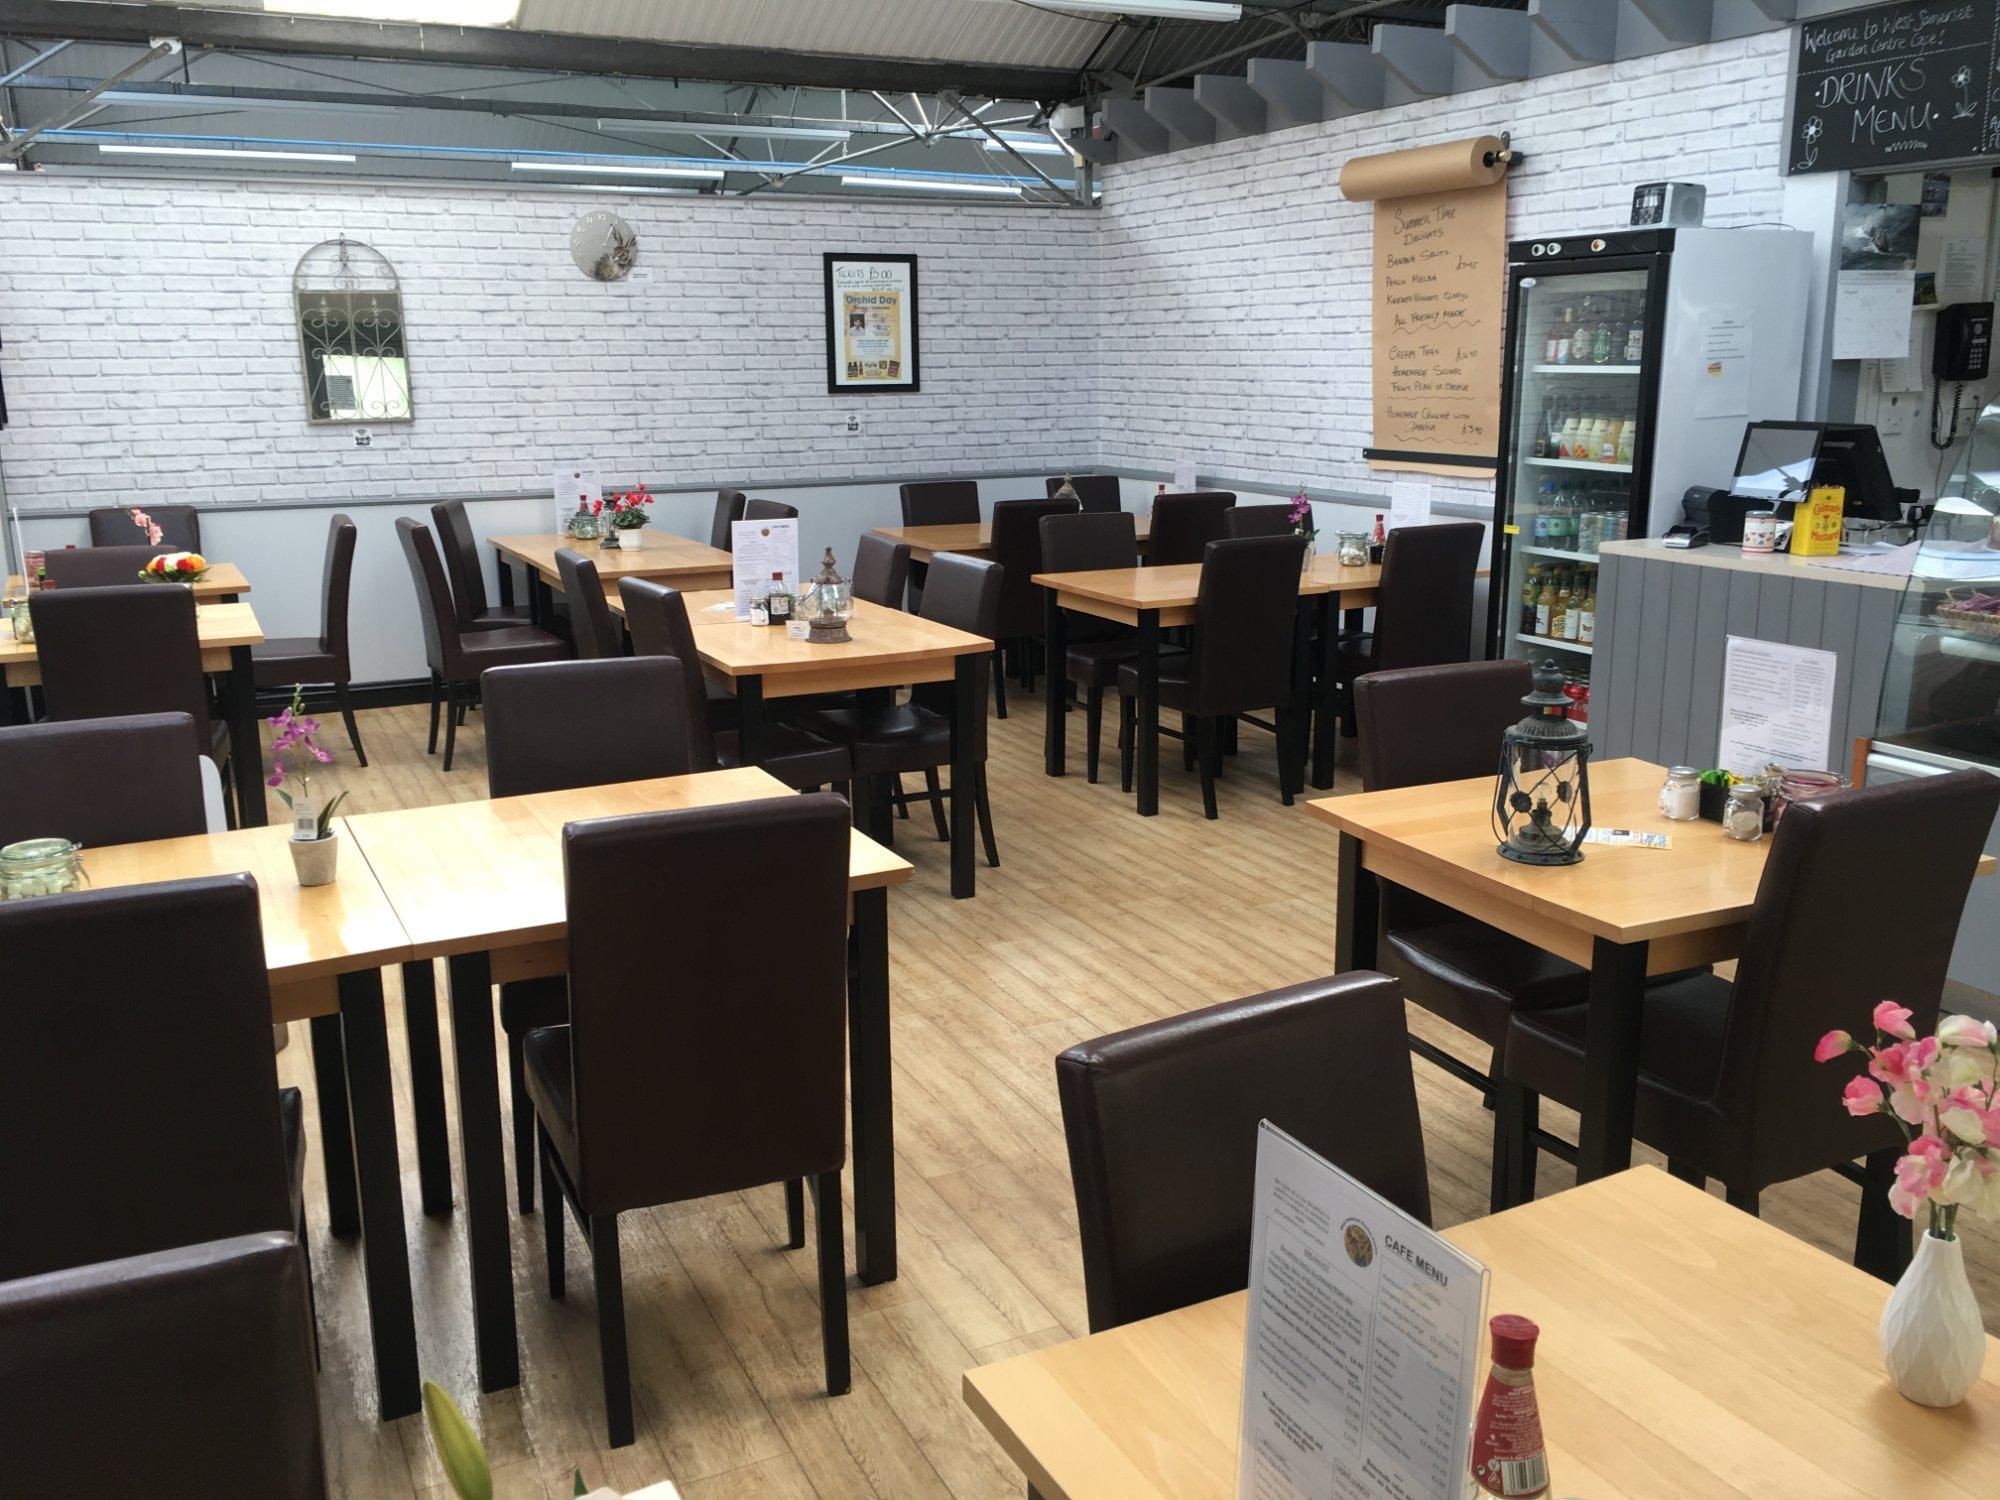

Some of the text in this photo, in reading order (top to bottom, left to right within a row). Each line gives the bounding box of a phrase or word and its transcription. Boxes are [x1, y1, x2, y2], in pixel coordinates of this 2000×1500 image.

[1805, 27, 1859, 53] Welcome
[1864, 19, 1879, 39] to
[1883, 15, 1915, 34] West
[1826, 43, 1868, 63] Garden
[1871, 37, 1906, 54] Centre
[1817, 58, 1926, 108] DRINKS
[1852, 102, 1932, 145] MENU
[846, 295, 897, 306] Orchid Day
[1385, 1235, 1413, 1263] CAFE
[1416, 1256, 1448, 1287] MENU
